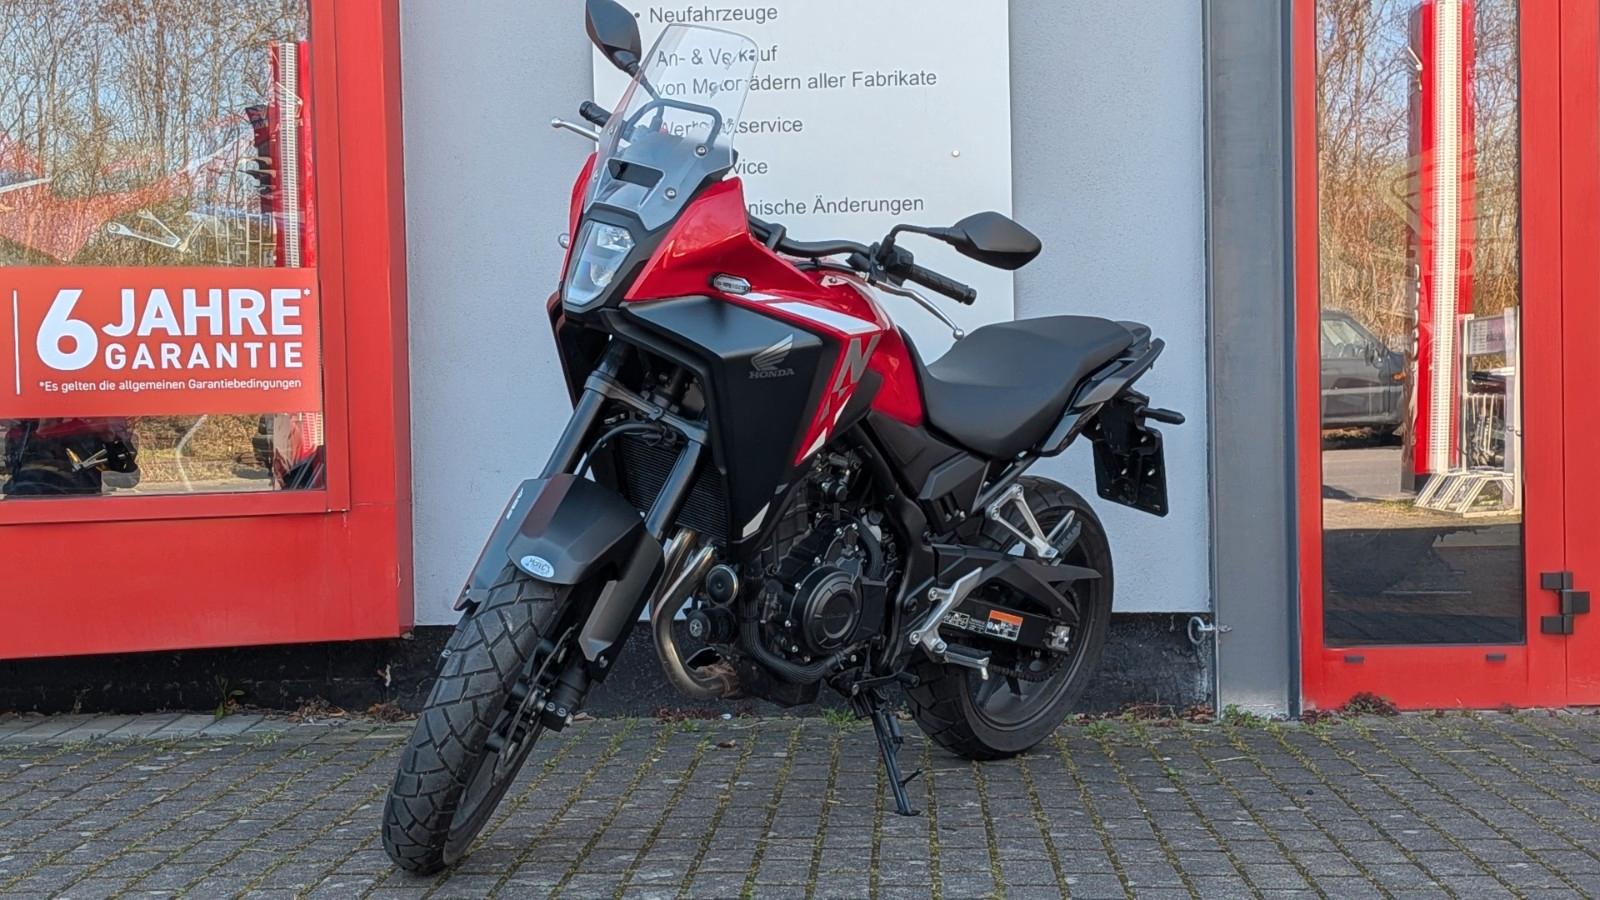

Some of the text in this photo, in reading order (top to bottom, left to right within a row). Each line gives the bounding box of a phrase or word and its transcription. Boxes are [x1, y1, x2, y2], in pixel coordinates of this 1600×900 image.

[649, 5, 778, 25] Neufahrzeuge
[656, 51, 686, 67] An-
[691, 48, 703, 65] &
[656, 82, 687, 96] von
[807, 72, 846, 88] aller
[852, 69, 938, 87] Fabrikate
[748, 195, 925, 216] nische Änderungen
[36, 289, 98, 371] 6
[105, 342, 303, 370] GARANTIE
[749, 368, 795, 379] HONDA
[61, 380, 96, 393] gelten
[99, 379, 115, 391] die
[118, 379, 186, 391] allgemeinen
[188, 377, 302, 390] Garantiebedingungen
